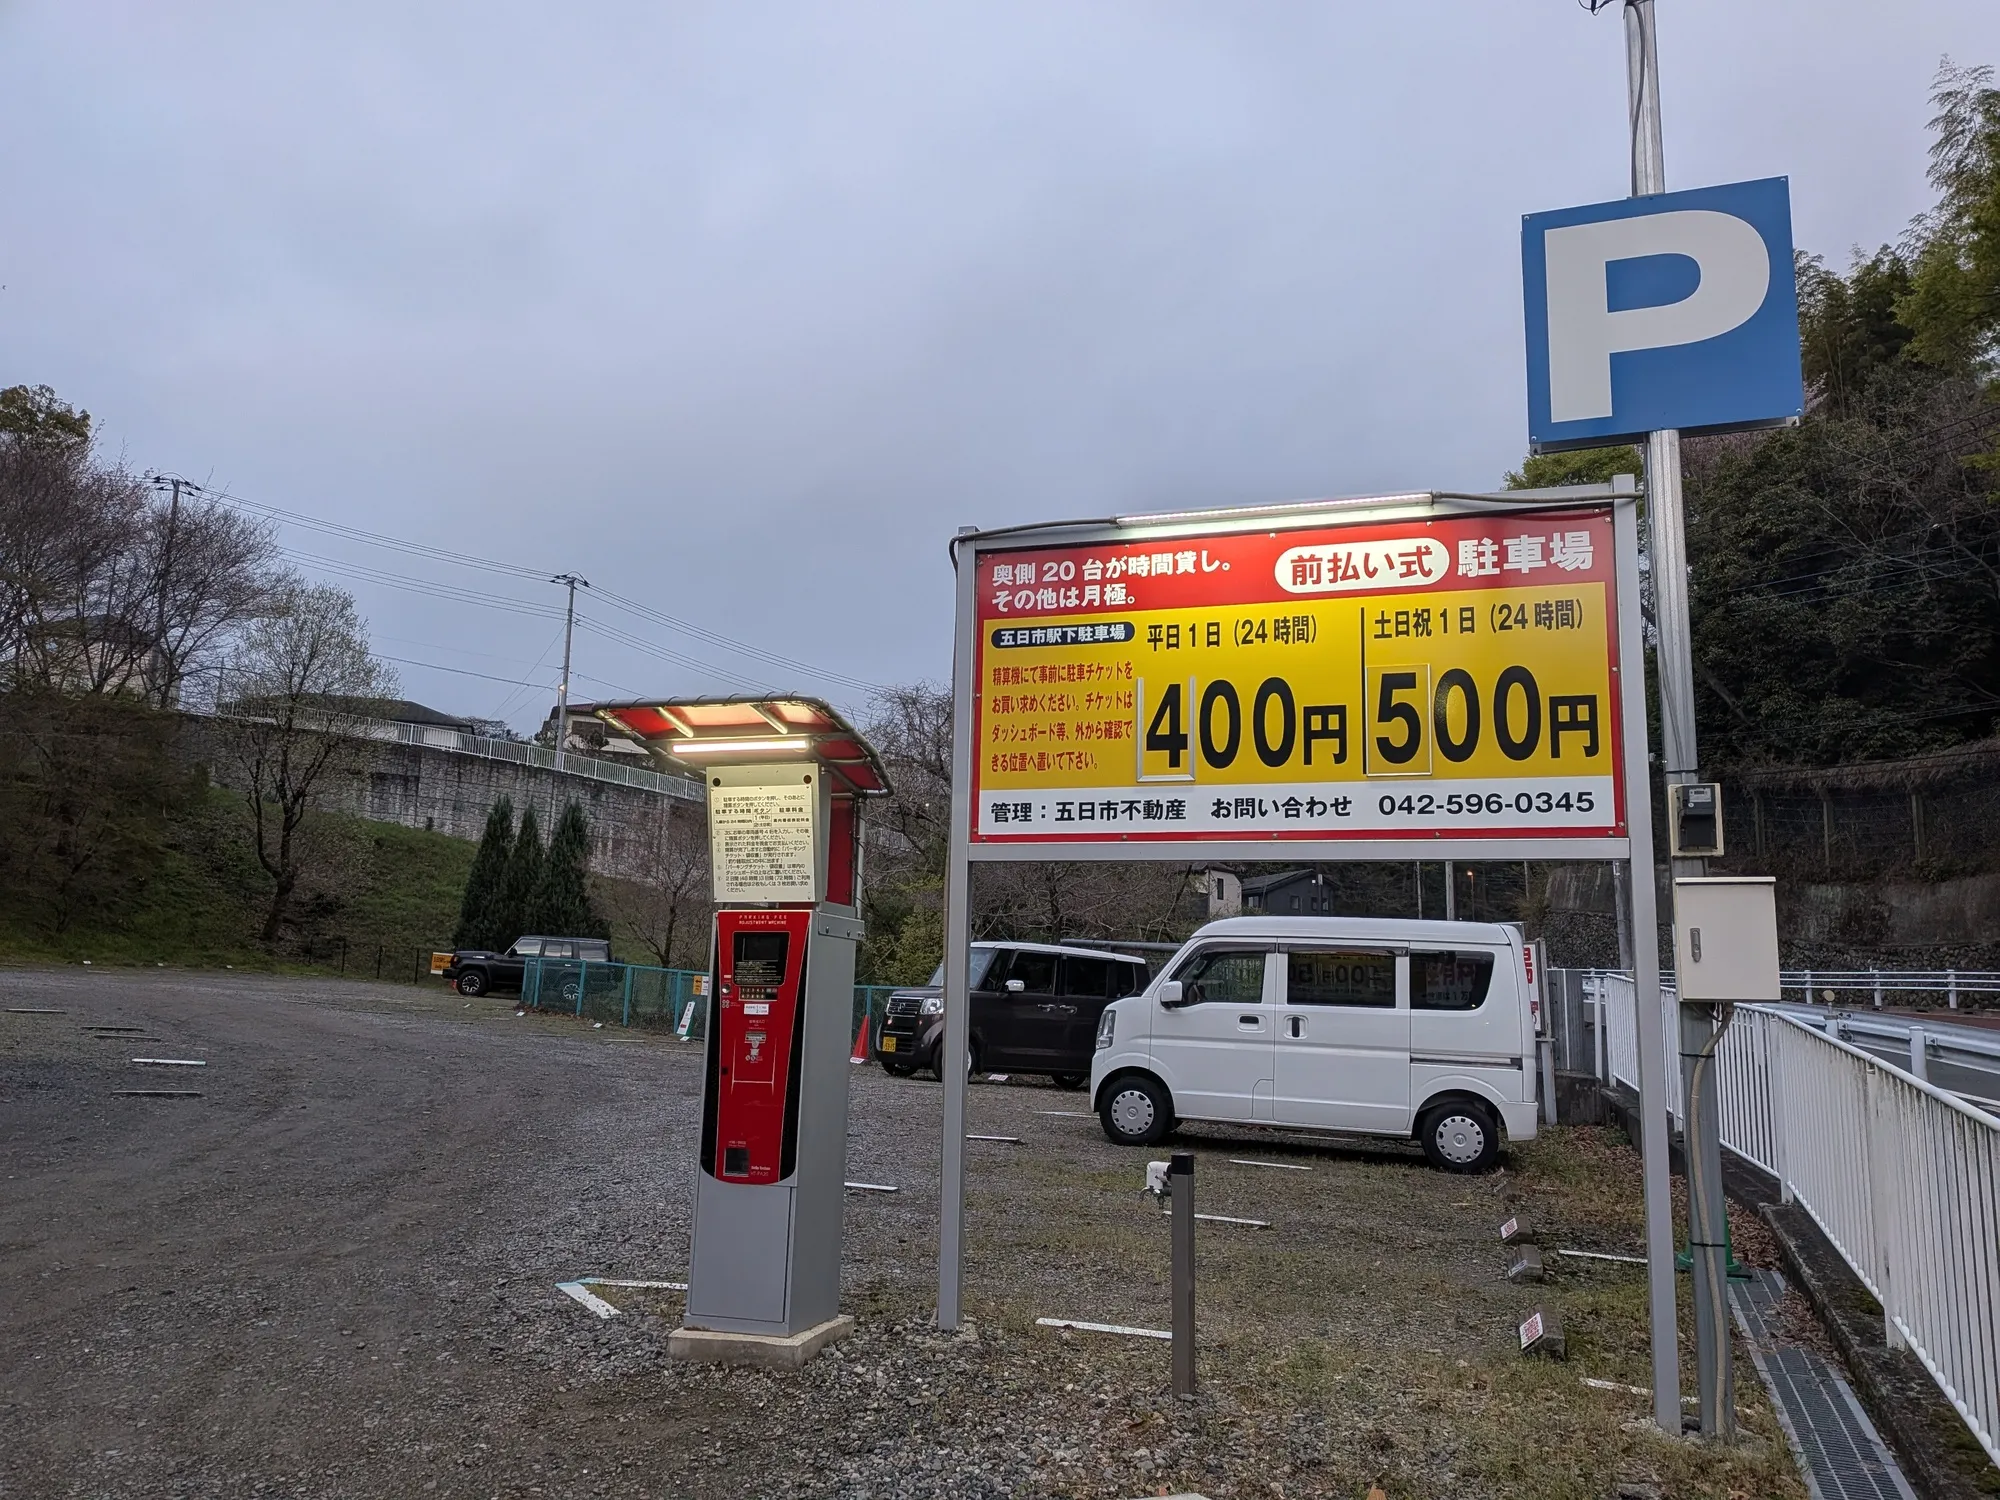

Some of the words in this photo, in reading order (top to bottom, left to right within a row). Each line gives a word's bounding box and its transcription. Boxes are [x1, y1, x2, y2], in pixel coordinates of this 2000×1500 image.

[1545, 210, 1770, 423] P
[1290, 545, 1432, 585] 前払い式
[1457, 531, 1593, 578] 駐車場
[992, 583, 1135, 612] その他は月極。
[1000, 624, 1125, 646] 五日市駅下駐車場
[993, 661, 1133, 686] 精算機にて事前に駐車チケットを
[992, 690, 1133, 714] お買い求めください。チケットは
[1376, 665, 1600, 764] 500円
[992, 720, 1133, 743] ダッシュボード等、外から確認で
[1146, 677, 1347, 769] 400円
[991, 751, 1098, 772] きる位置へ置いて下さい。
[1210, 796, 1352, 819] お問い合わせ
[1379, 791, 1595, 816] 042-596-0345
